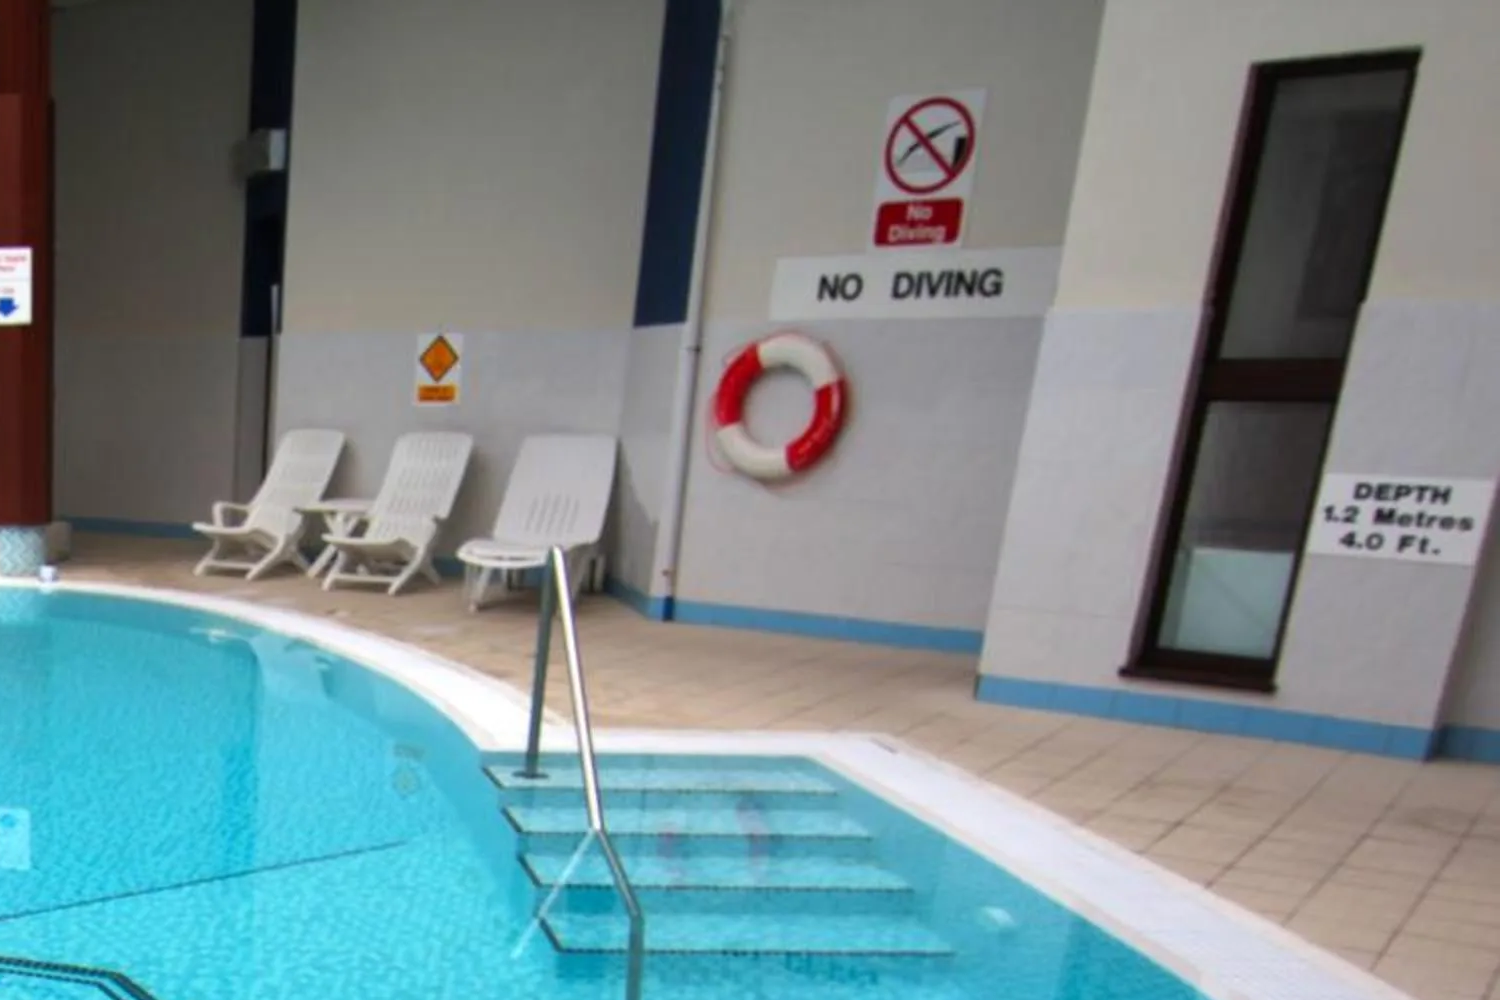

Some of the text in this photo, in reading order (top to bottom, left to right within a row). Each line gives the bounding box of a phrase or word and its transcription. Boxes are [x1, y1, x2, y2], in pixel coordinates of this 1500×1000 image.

[906, 203, 933, 220] No
[888, 224, 947, 244] Diving
[816, 268, 1004, 302] NO DIVING
[1352, 482, 1453, 505] DEPTH
[1323, 505, 1475, 532] 1.2 Metres
[1338, 531, 1441, 555] 4.0 Ft.
